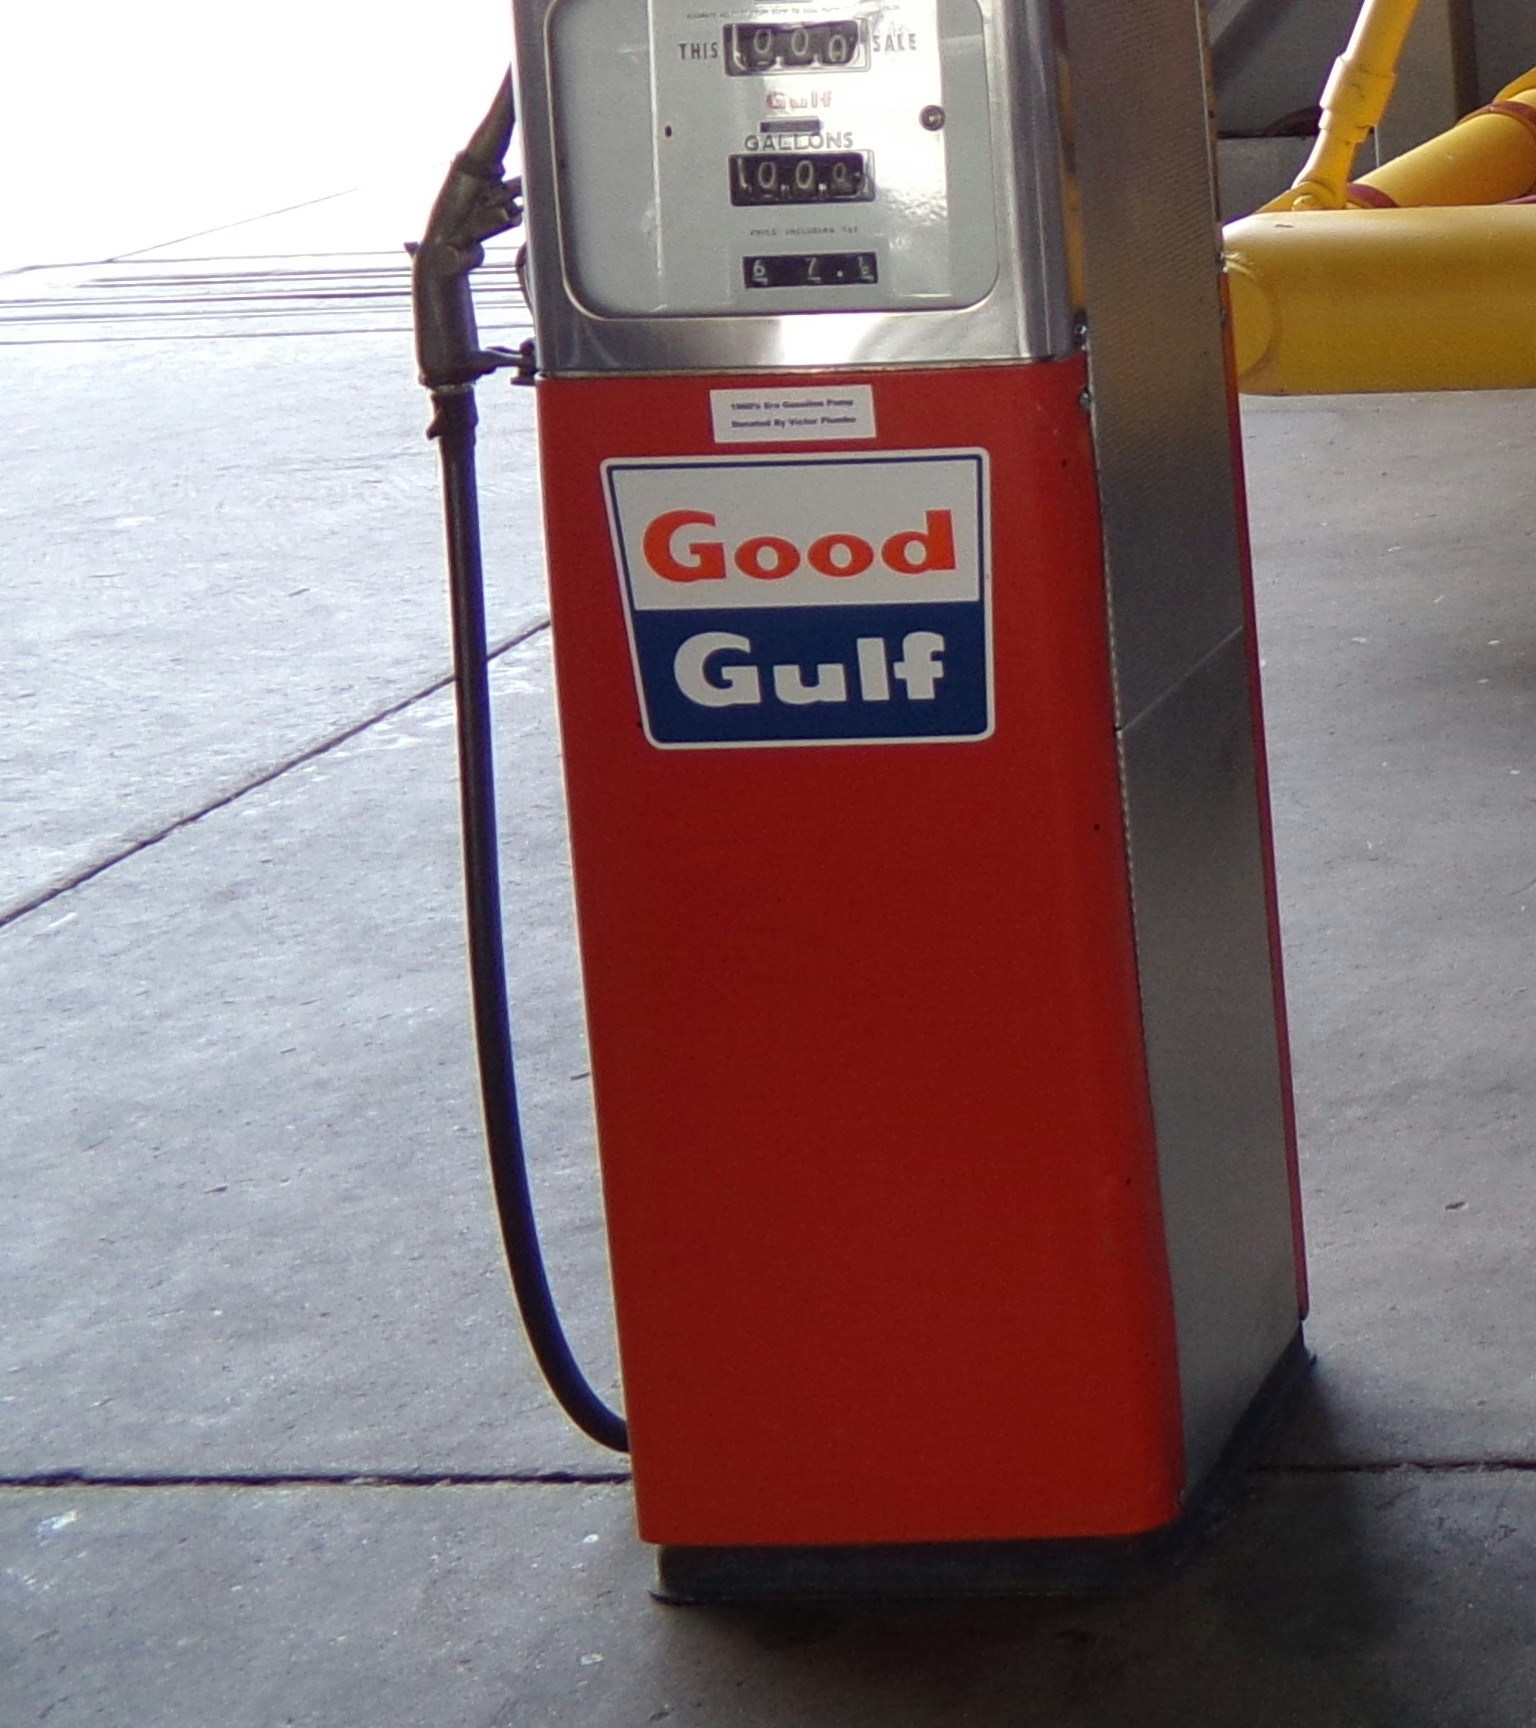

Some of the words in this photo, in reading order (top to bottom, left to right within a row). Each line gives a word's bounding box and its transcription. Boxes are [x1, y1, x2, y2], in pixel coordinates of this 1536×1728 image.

[679, 42, 720, 61] THIS
[872, 32, 918, 53] SALE
[765, 89, 833, 110] Gulf
[744, 131, 855, 152] GALLONS
[643, 509, 956, 583] Good
[674, 631, 945, 708] Gulf
